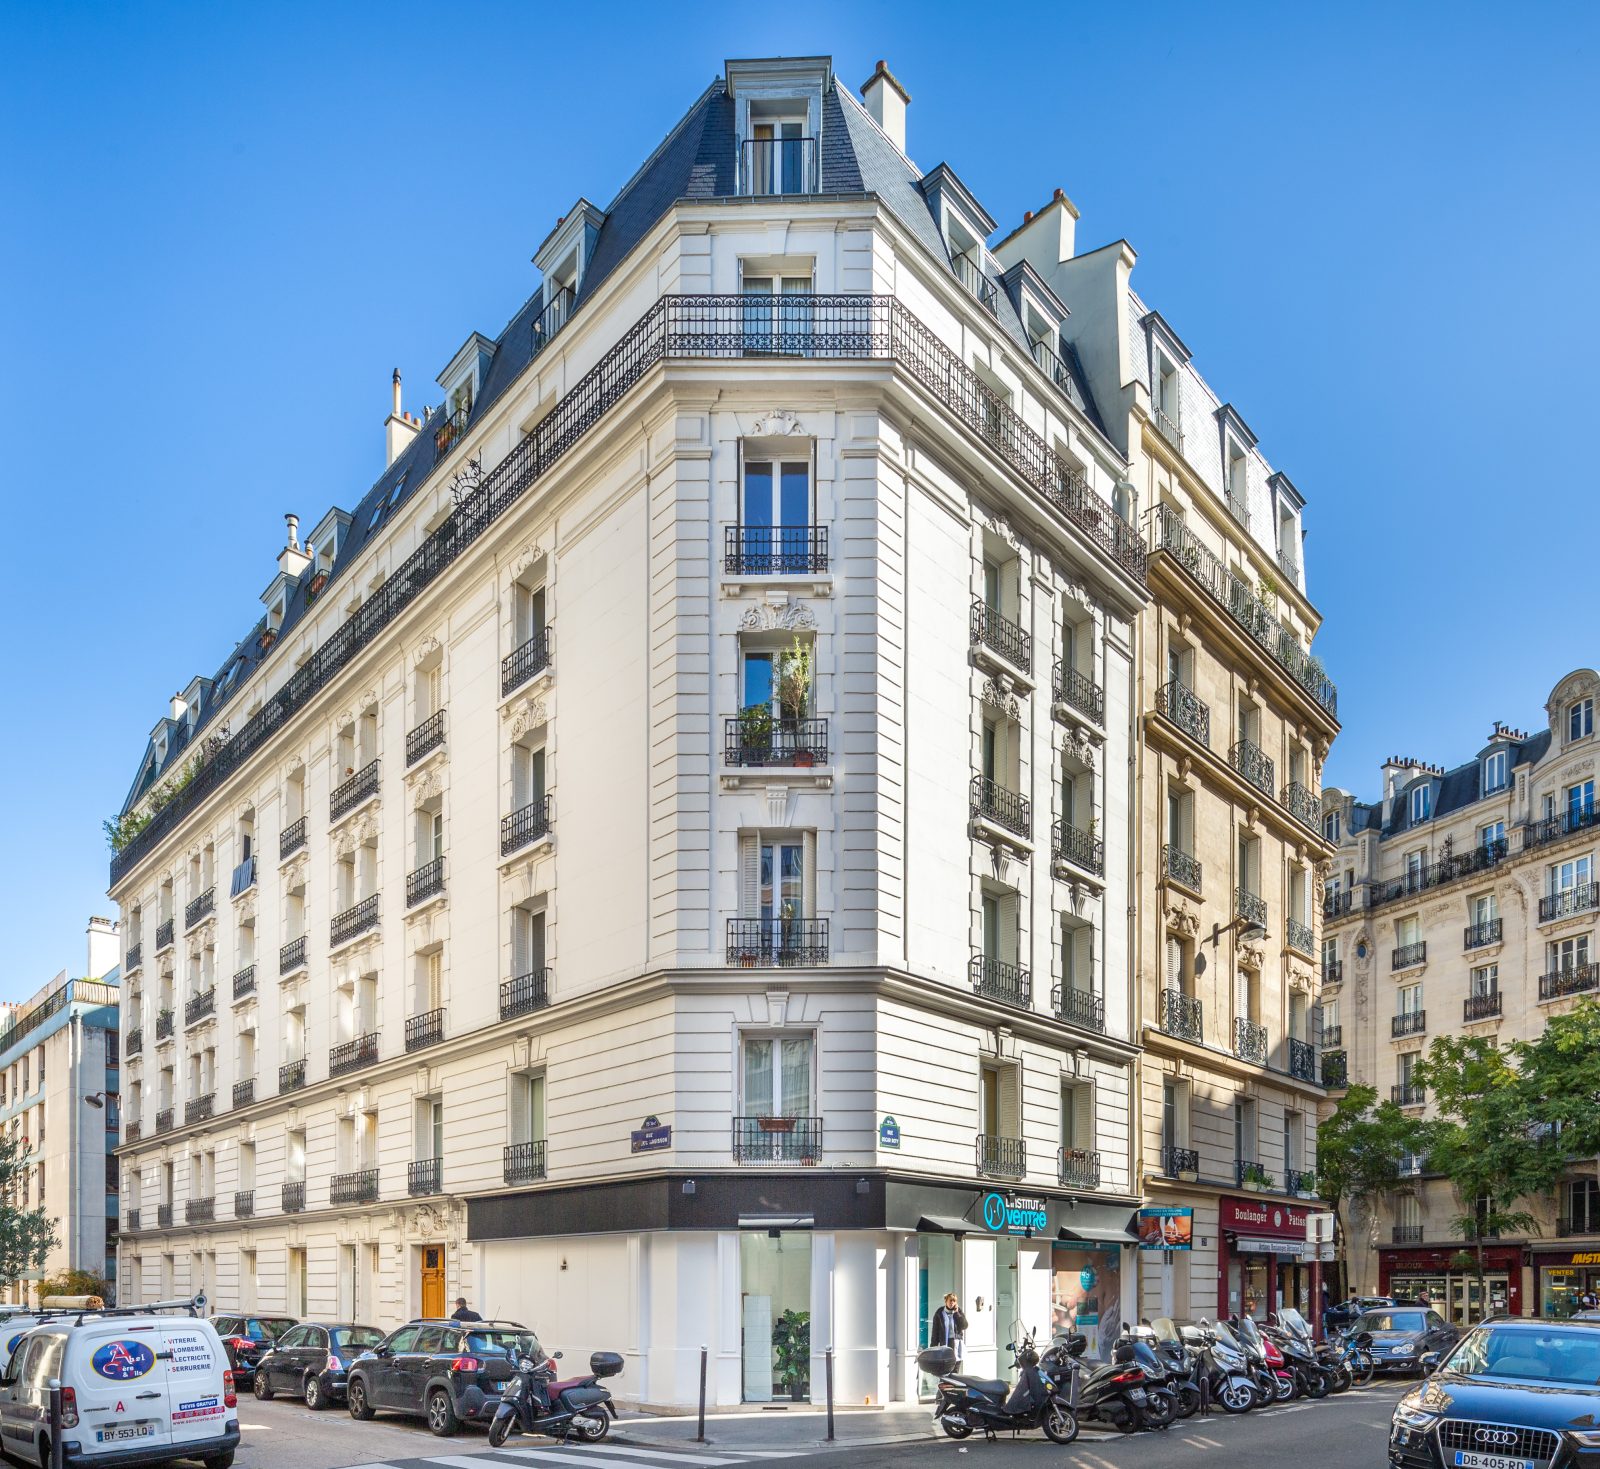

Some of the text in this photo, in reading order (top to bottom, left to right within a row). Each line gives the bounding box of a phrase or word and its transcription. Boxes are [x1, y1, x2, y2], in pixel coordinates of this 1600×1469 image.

[1005, 1198, 1040, 1210] LINSTITUT
[1235, 1207, 1307, 1227] Boulanger Pâtiss
[170, 1346, 204, 1354] PLOMBERIE
[171, 1355, 211, 1363] ELECTRICITE
[172, 1364, 211, 1372] SERRURERIE
[116, 1401, 125, 1412] A
[1463, 1454, 1525, 1469] DB-405-RD
